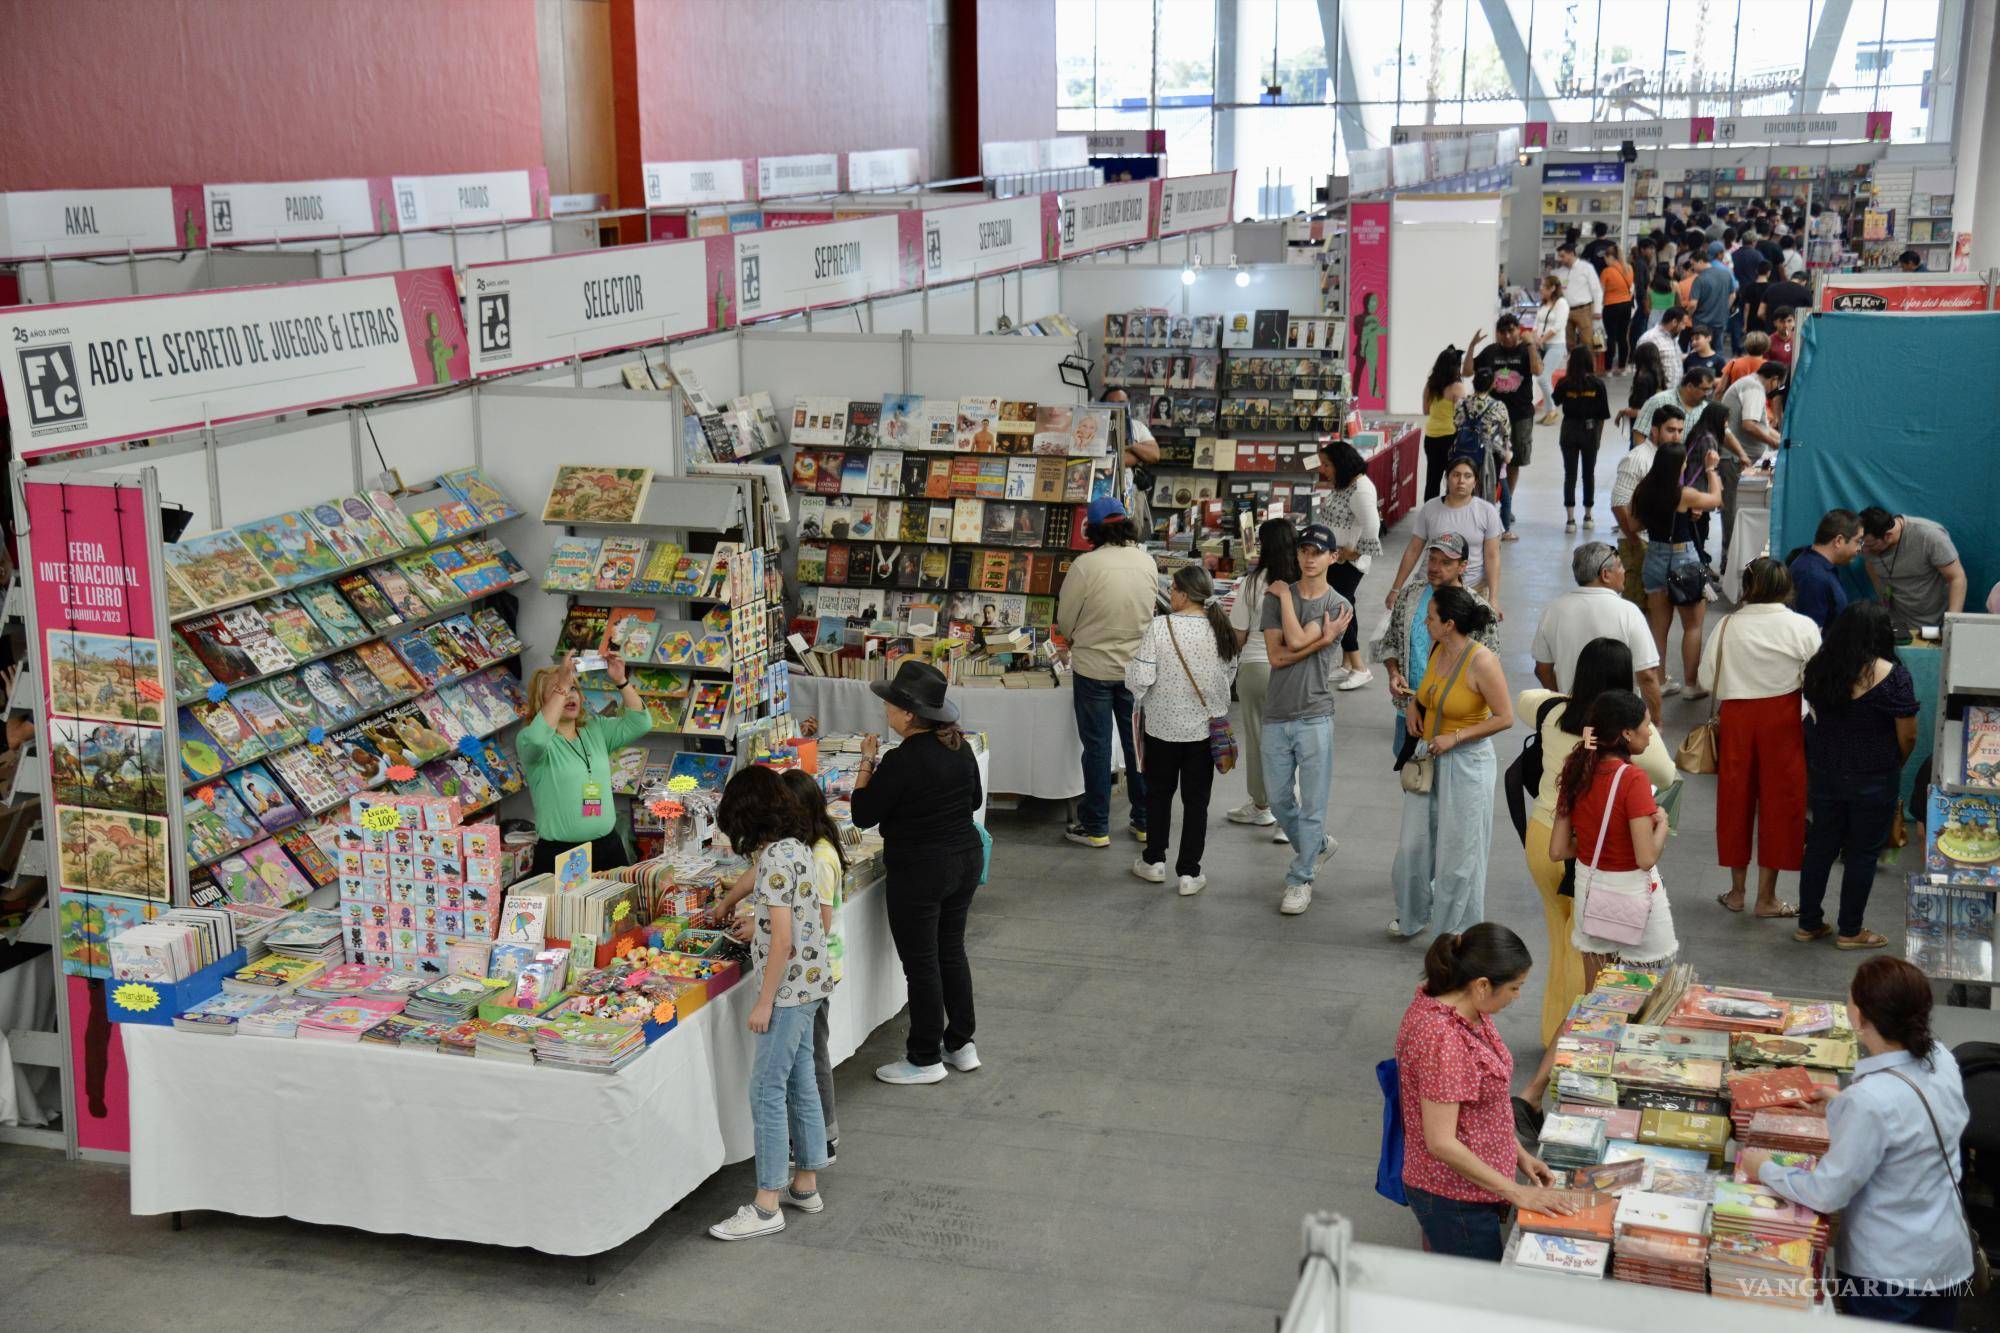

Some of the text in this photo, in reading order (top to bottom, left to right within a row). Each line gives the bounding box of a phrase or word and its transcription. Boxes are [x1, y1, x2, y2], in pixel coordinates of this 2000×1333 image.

[1594, 128, 1634, 140] EDICIONES
[1764, 120, 1837, 134] EDICIONES URANO
[285, 194, 324, 222] PAIDOS
[65, 206, 99, 236] AKAL
[979, 219, 1012, 250] SEPRECOM
[815, 240, 861, 279] SEPRECOM
[584, 274, 644, 320] SELECTOR
[12, 326, 29, 343] 25
[88, 307, 399, 386] ABC EL SECRETO DE JUEGOS & LETRAS
[69, 542, 105, 563] FERIA
[40, 562, 140, 587] INTERNACIONAL
[60, 585, 122, 608] DEL LIBRO
[192, 885, 222, 905] WORD
[1951, 888, 1961, 897] LA
[508, 900, 543, 910] colores
